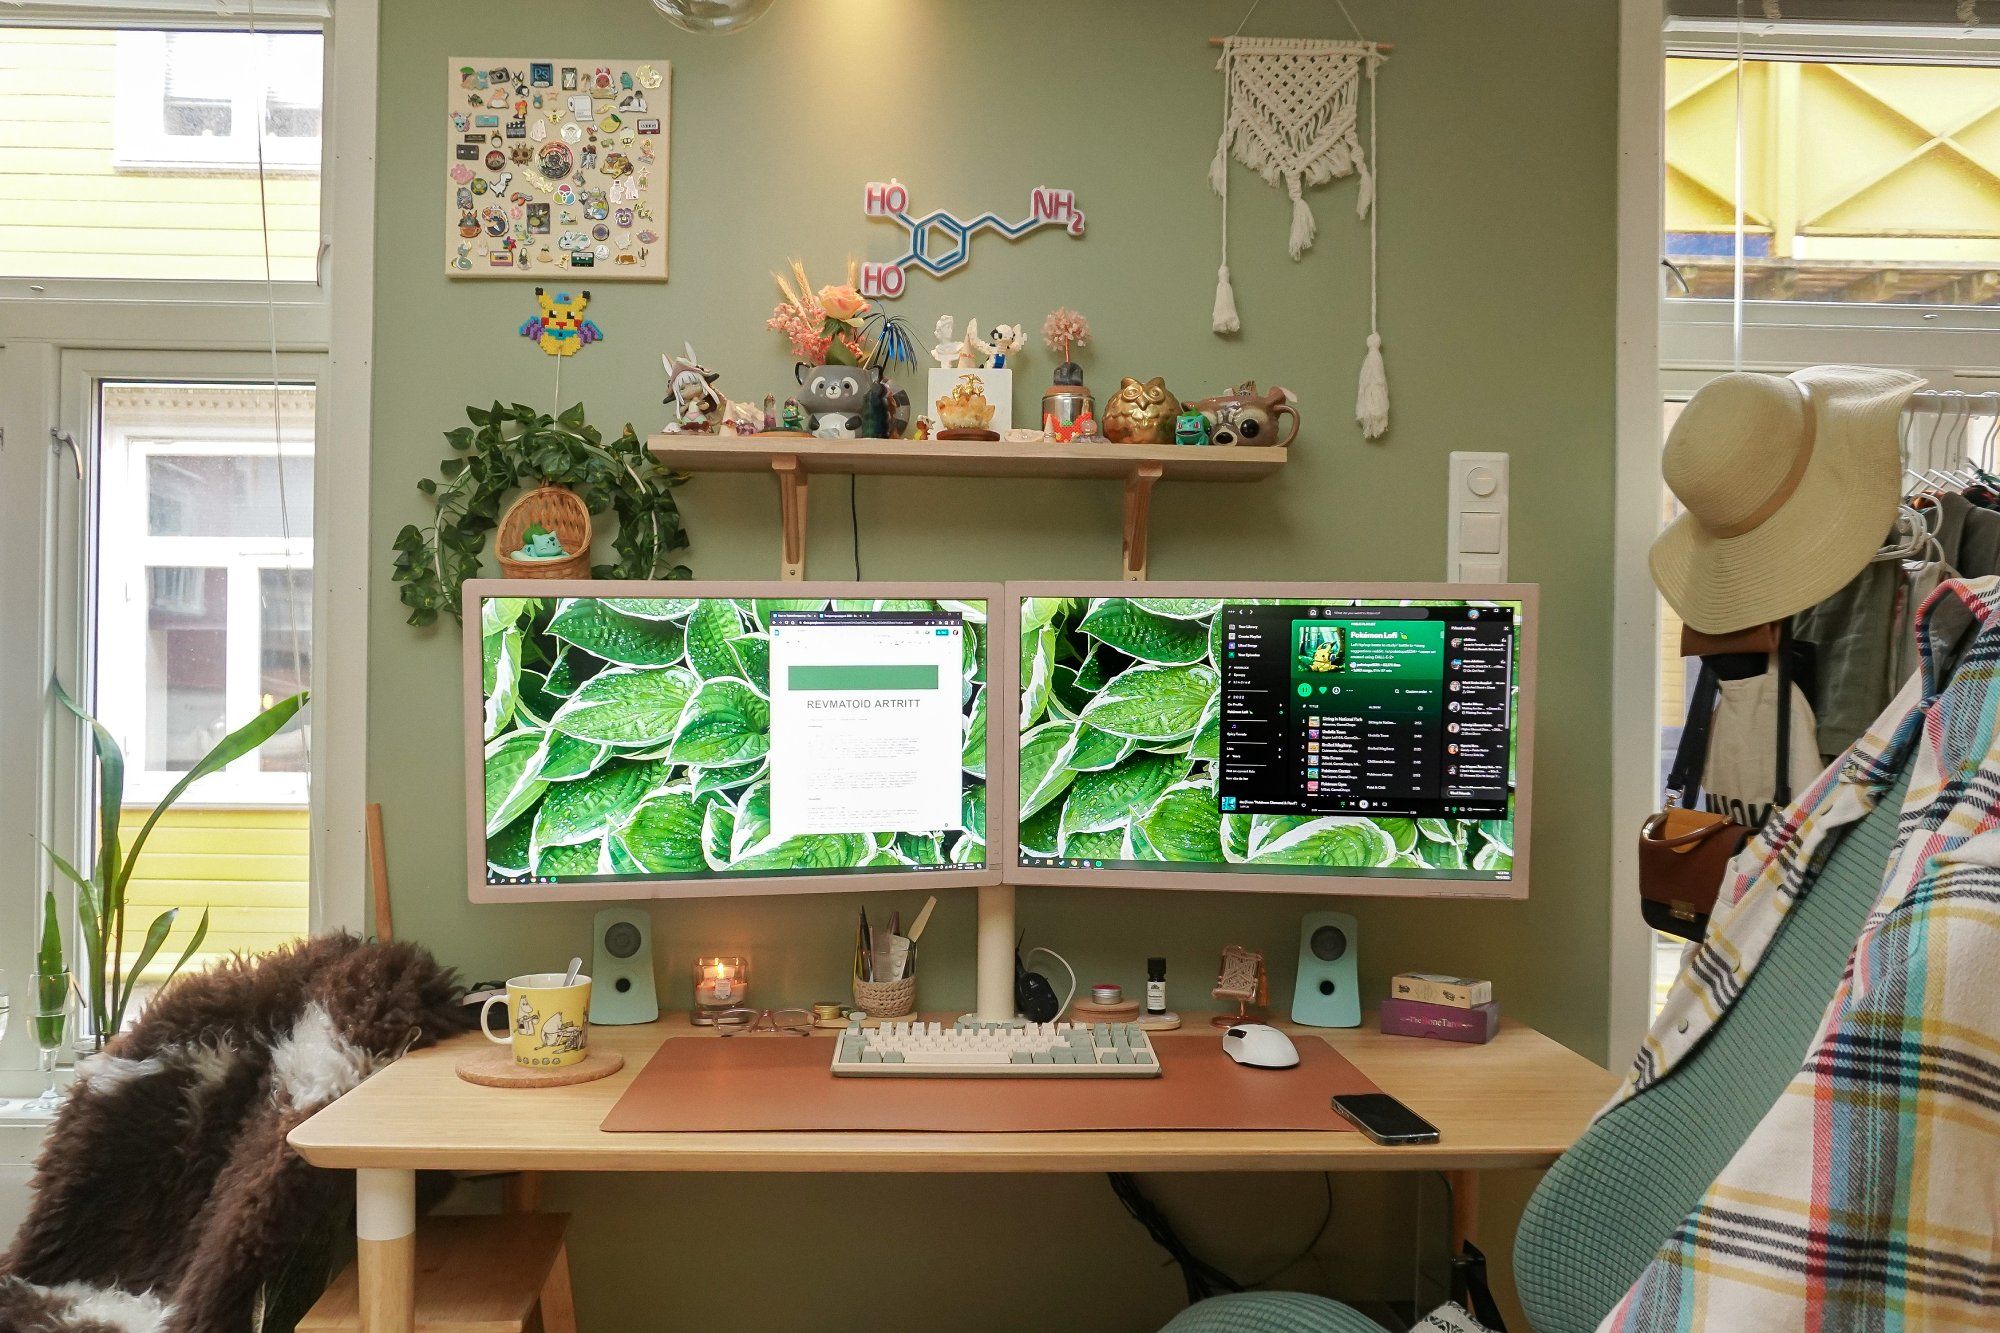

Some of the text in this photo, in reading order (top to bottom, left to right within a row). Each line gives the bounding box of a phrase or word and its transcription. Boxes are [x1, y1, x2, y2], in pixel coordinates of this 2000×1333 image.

[534, 68, 548, 80] Ps
[867, 185, 906, 214] HO
[864, 264, 902, 294] HO
[807, 699, 920, 709] REVMATOID ARTRITT
